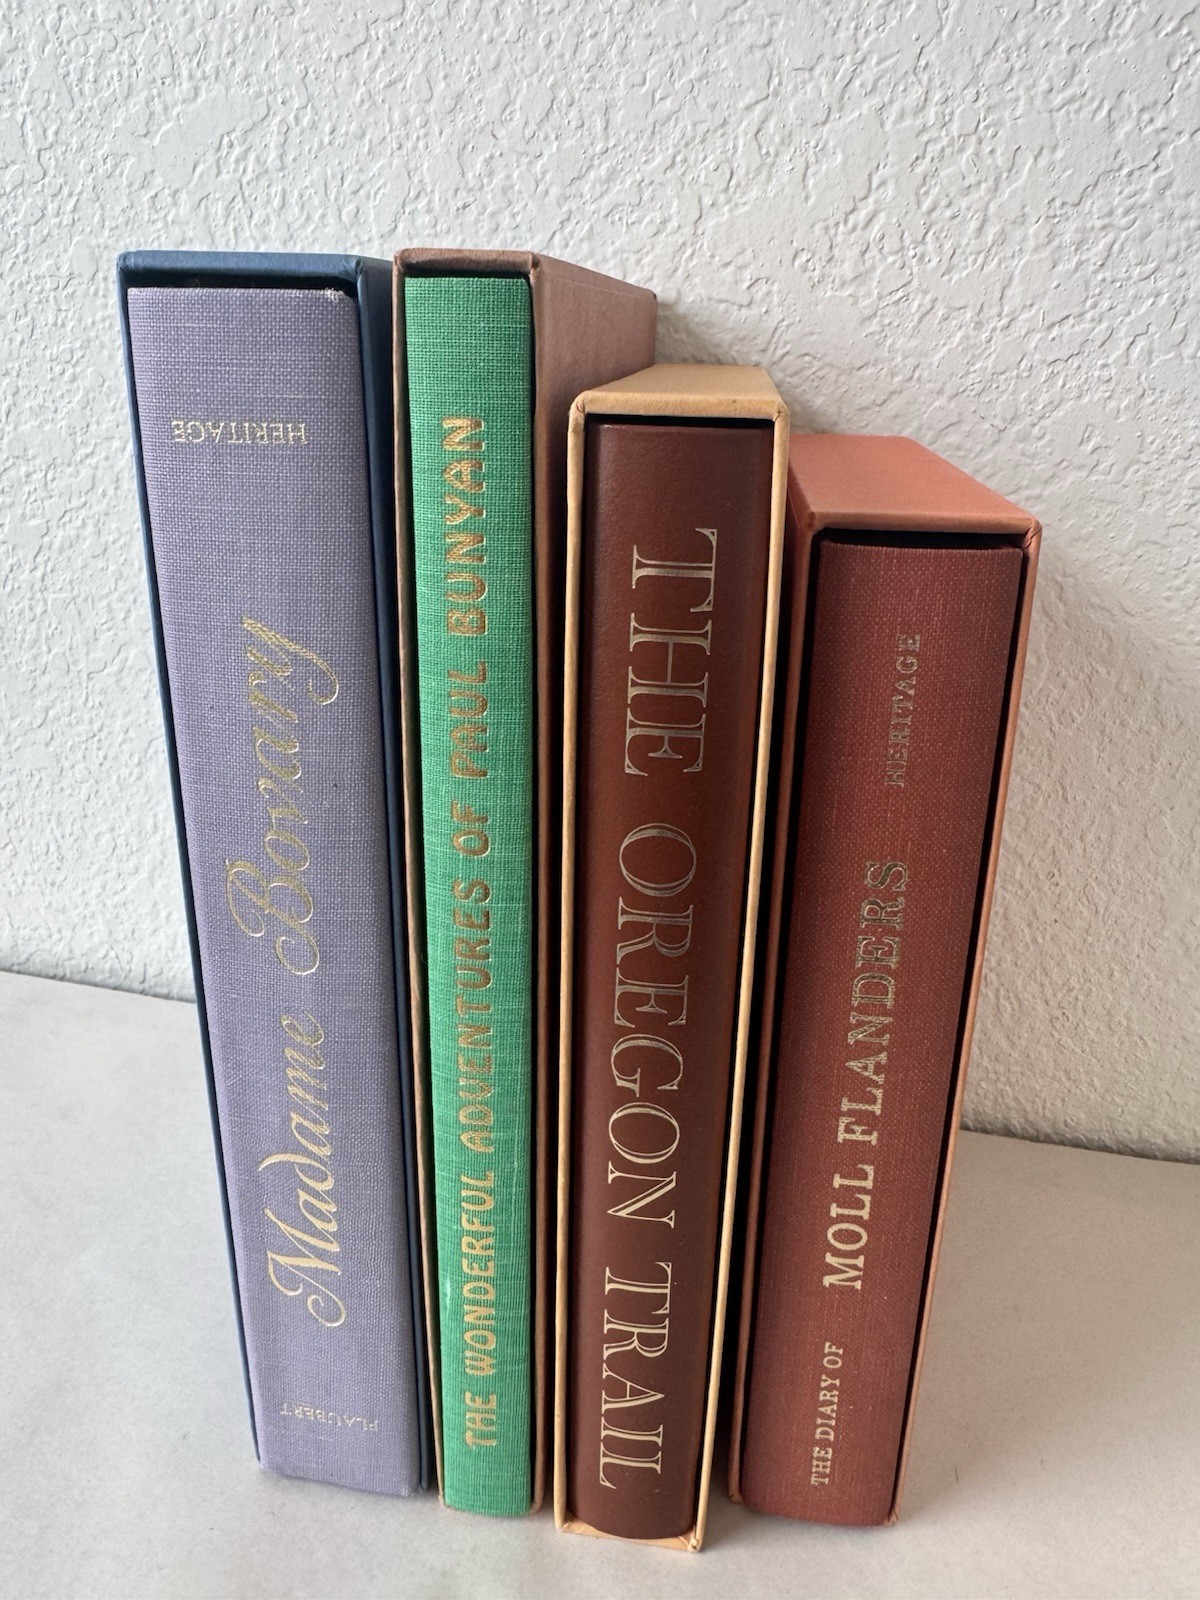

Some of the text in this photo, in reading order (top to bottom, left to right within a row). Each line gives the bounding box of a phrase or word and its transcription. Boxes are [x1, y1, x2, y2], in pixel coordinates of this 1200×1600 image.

[170, 419, 308, 446] HERITAGE
[884, 632, 921, 788] HERITAGE
[225, 615, 346, 1328] Madame Bovary
[441, 416, 498, 1448] THE WONDERFUL ADVENTURES OF PAUL BUNYAN
[600, 527, 718, 1490] THE OREGON TRAIL
[823, 860, 909, 1290] MOLL FLANDERS
[277, 1401, 379, 1433] FLAUBERT
[811, 1341, 845, 1486] THE DIARY OF
